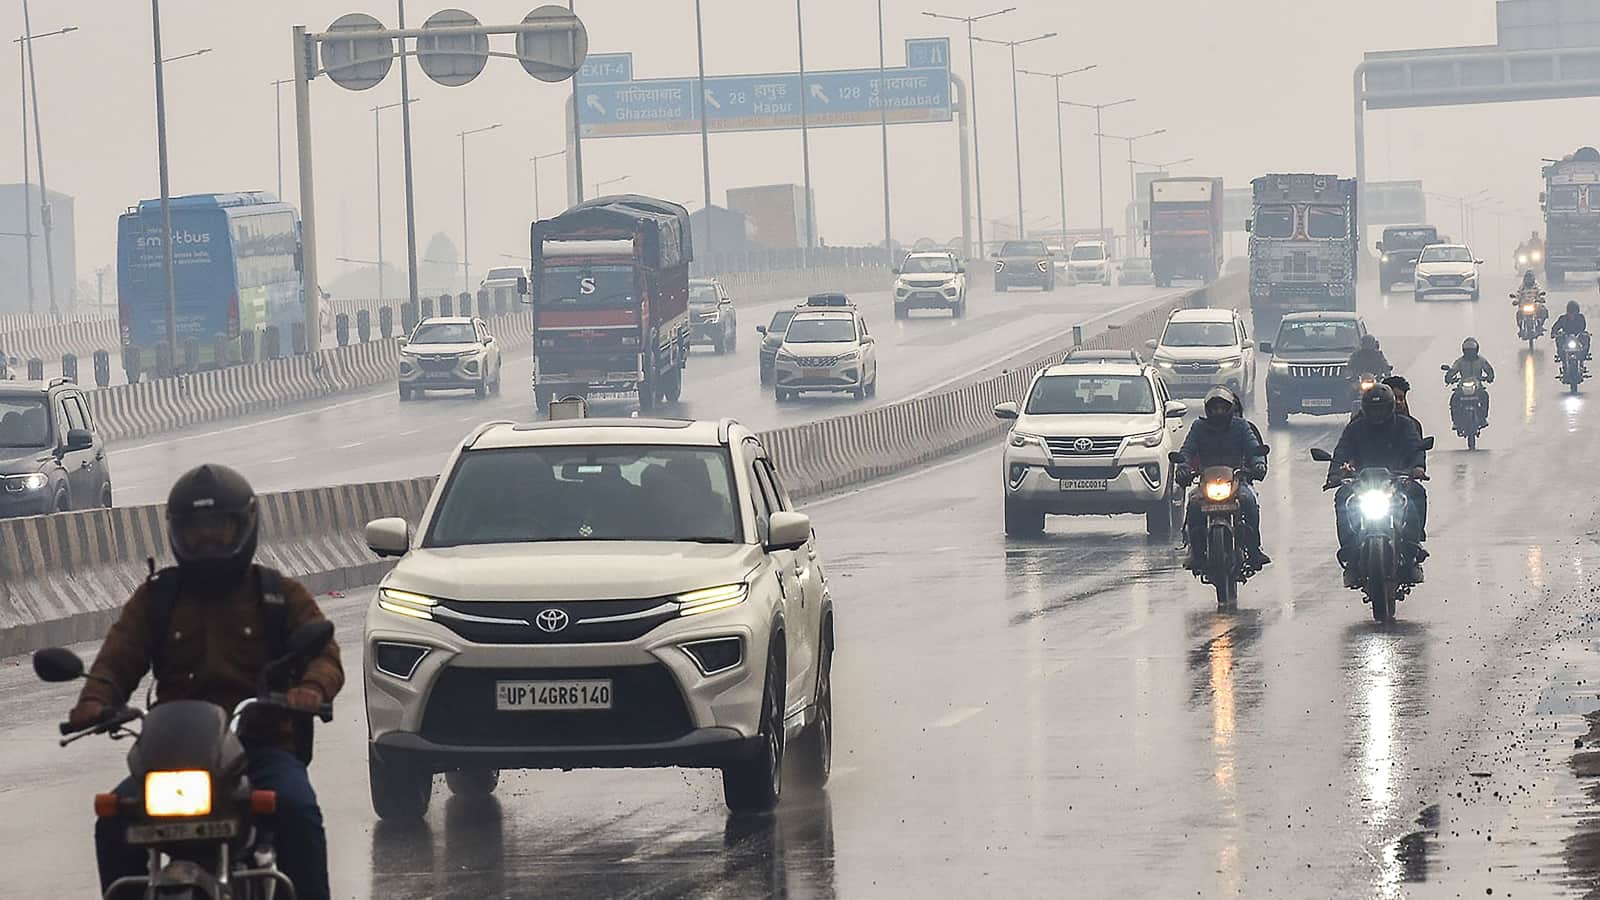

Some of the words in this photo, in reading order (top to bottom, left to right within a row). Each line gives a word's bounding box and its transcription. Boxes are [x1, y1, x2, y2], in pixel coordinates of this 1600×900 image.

[581, 64, 625, 76] EXIT-4
[839, 87, 861, 99] 128
[869, 76, 929, 96] मुादाबाद
[615, 86, 681, 102] गाजियाबाद
[728, 92, 745, 104] 28
[615, 107, 681, 120] Ghaziabad
[753, 102, 793, 114] Hapur
[137, 230, 210, 247] smtbus
[580, 277, 596, 295] S
[507, 686, 609, 705] UP14GR6140
